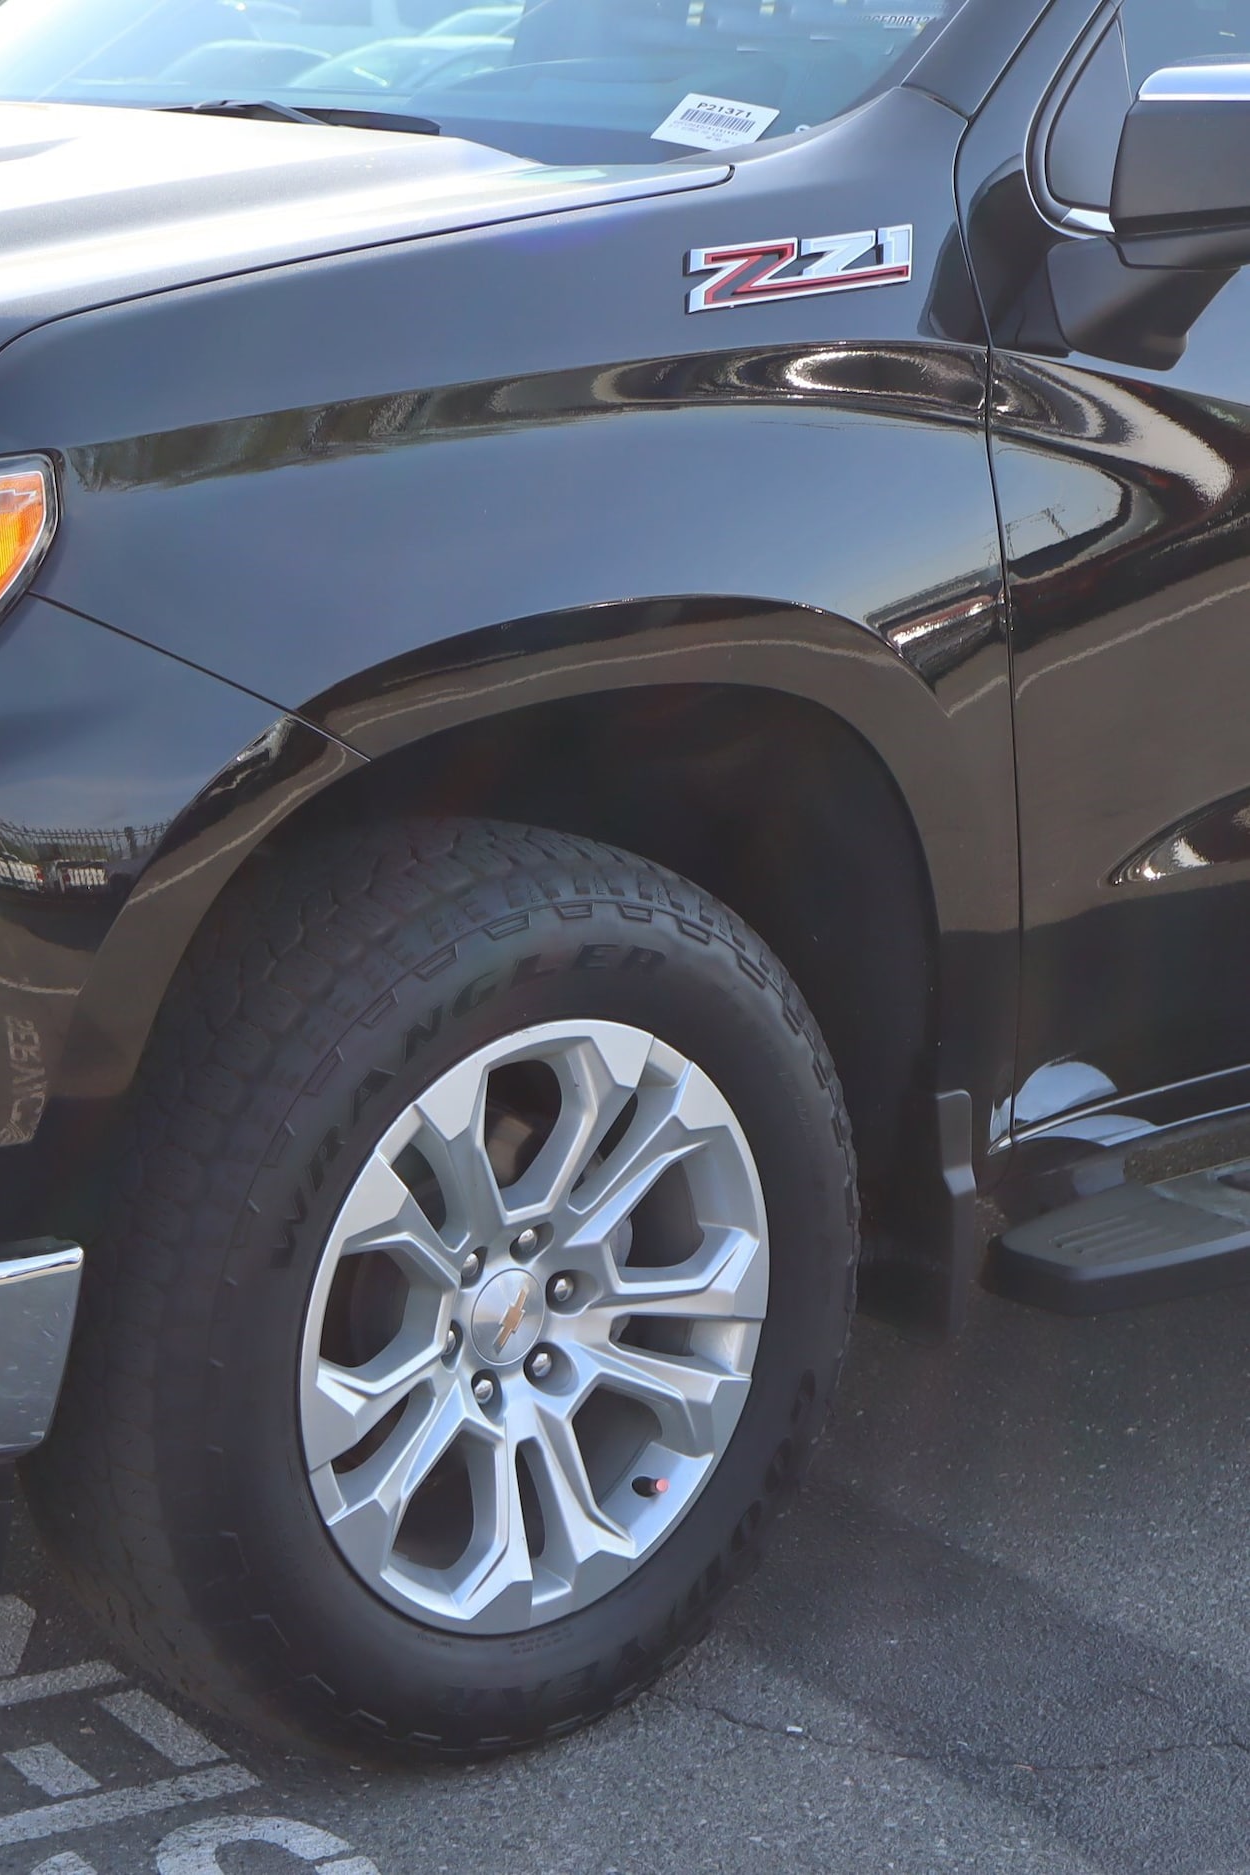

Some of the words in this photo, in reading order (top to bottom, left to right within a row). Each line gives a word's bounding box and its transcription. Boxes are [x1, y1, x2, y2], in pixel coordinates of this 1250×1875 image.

[696, 102, 753, 118] P21371
[686, 223, 913, 314] Z71
[270, 942, 668, 1270] WRANGLER
